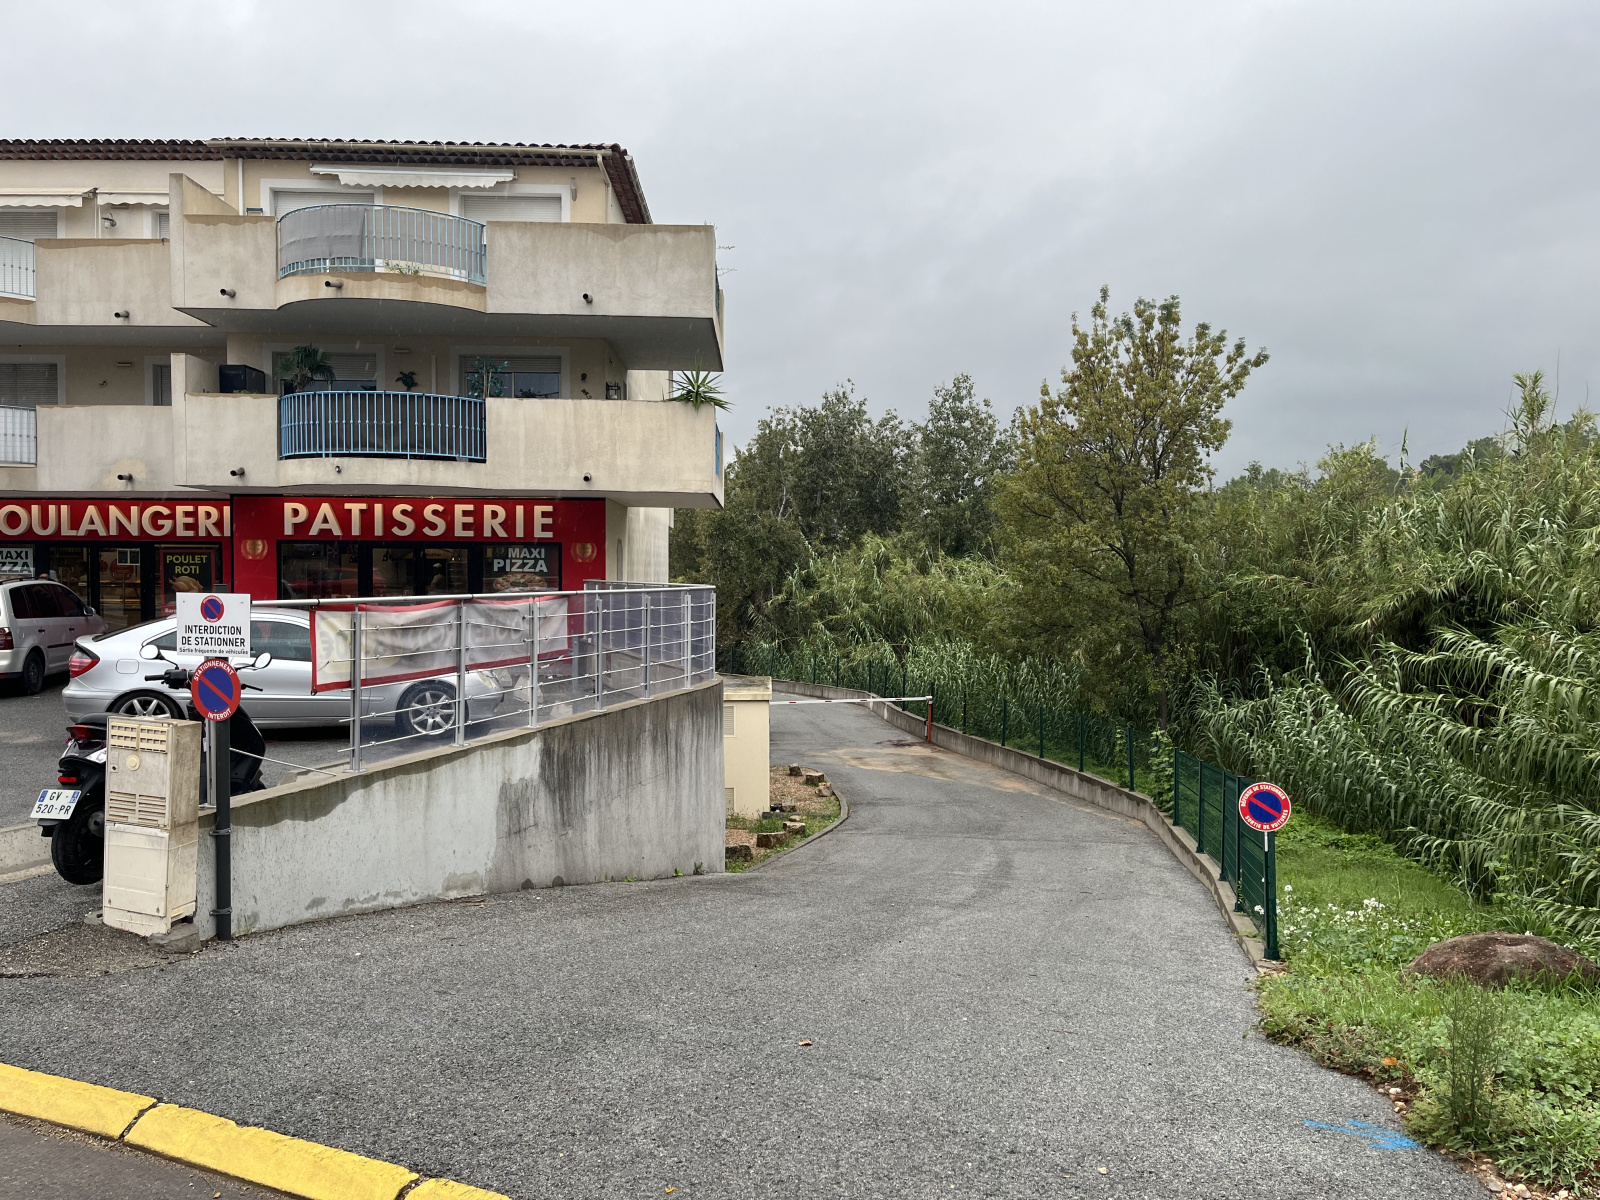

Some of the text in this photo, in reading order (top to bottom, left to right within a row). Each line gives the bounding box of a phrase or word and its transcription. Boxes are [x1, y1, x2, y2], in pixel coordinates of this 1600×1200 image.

[283, 502, 555, 538] PATISSERIE
[508, 547, 545, 559] MAXI
[166, 555, 208, 564] POULET
[493, 558, 548, 573] PIZZA
[175, 565, 200, 574] ROTI
[184, 624, 242, 636] INTERDICTION
[181, 636, 246, 648] DE STATIONNER
[194, 647, 218, 655] fréquente
[193, 660, 235, 682] STATIONNEMENT
[207, 708, 232, 720] INTERDIT
[1260, 785, 1287, 800] STATIONNER
[35, 804, 72, 815] 520-PR
[1245, 815, 1262, 829] SORTIE
[1270, 809, 1289, 829] VOITURES
